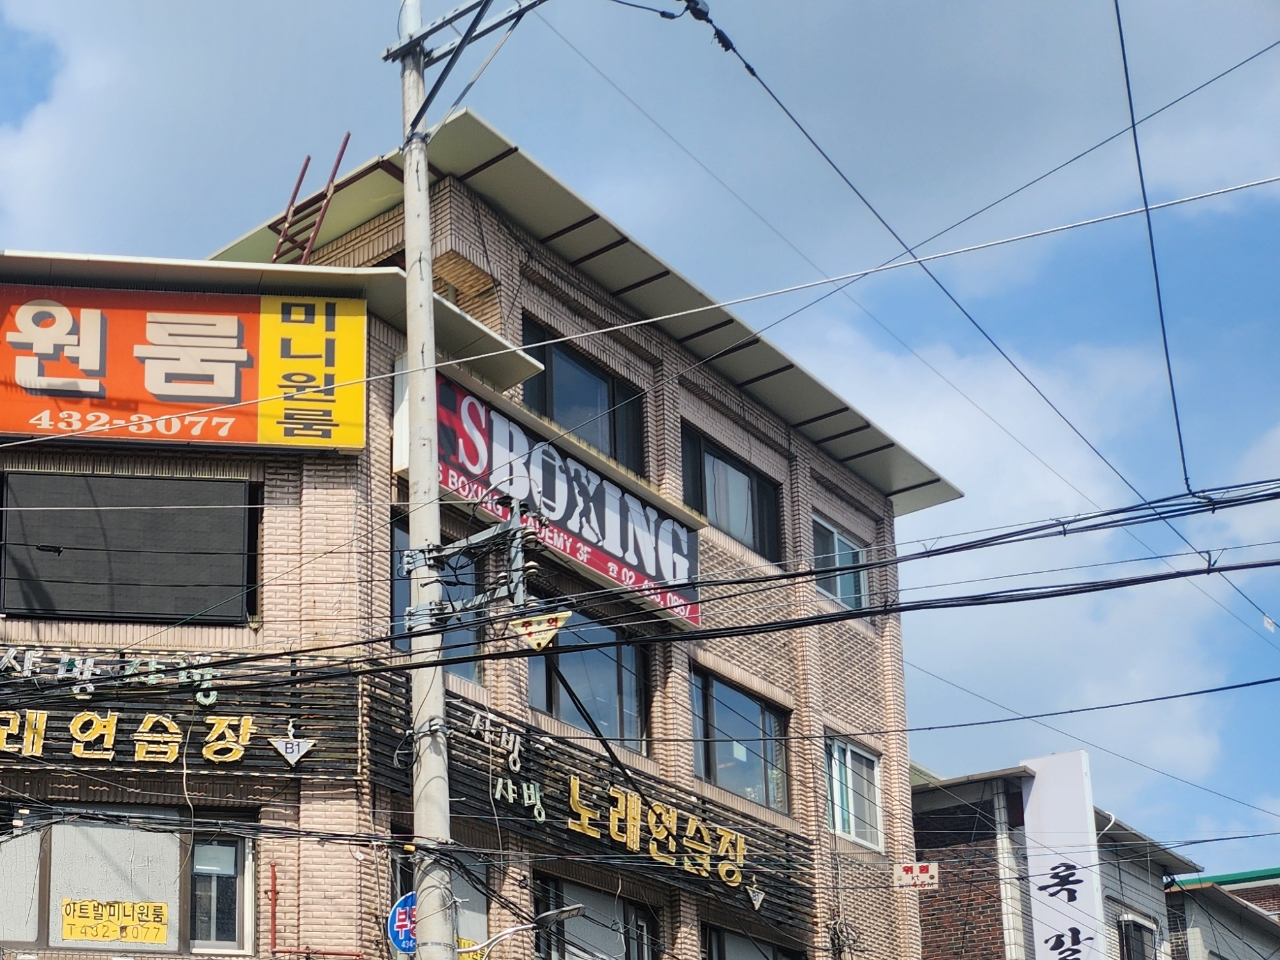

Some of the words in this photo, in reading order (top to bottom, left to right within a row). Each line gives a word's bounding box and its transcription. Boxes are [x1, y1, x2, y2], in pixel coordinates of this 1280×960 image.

[6, 299, 248, 399] 원룸
[275, 301, 340, 440] 미니원룸
[28, 408, 237, 437] 432-3077
[575, 541, 592, 563] 3F
[284, 741, 303, 756] B1
[493, 777, 548, 824] 샤방
[565, 774, 748, 889] 노래연습장
